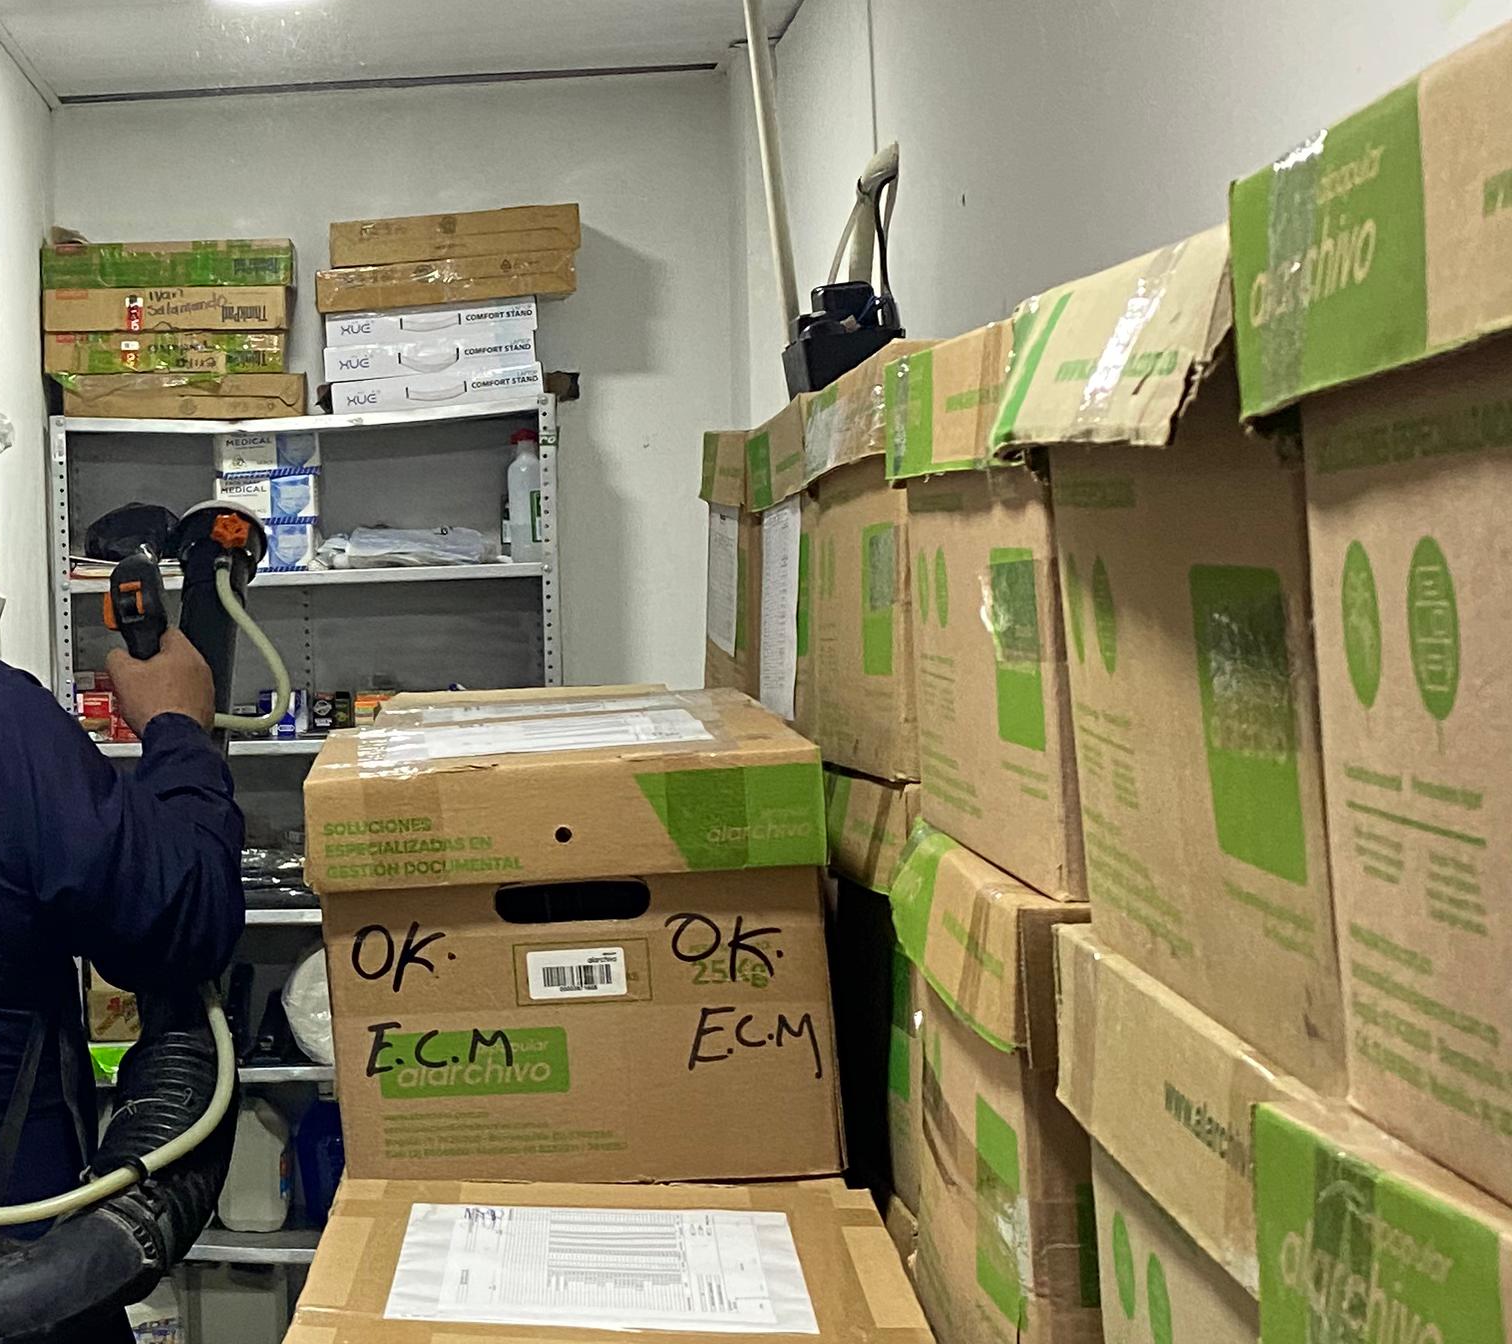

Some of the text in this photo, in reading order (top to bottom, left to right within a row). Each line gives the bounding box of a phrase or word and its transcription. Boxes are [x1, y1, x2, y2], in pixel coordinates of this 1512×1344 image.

[465, 312, 505, 321] COMFORT
[505, 309, 533, 317] STAND
[464, 346, 503, 355] COMFORT
[471, 378, 510, 388] COMFORT
[511, 375, 539, 384] STAND
[225, 437, 272, 447] MEDICAL
[220, 482, 268, 494] MEDICAL
[323, 816, 432, 836] SOLUCIONES
[706, 821, 811, 846] alarchivo
[324, 836, 493, 857] ESPECIALIZADAS EN
[327, 856, 523, 879] GESTIÓN DOCUMENTAL
